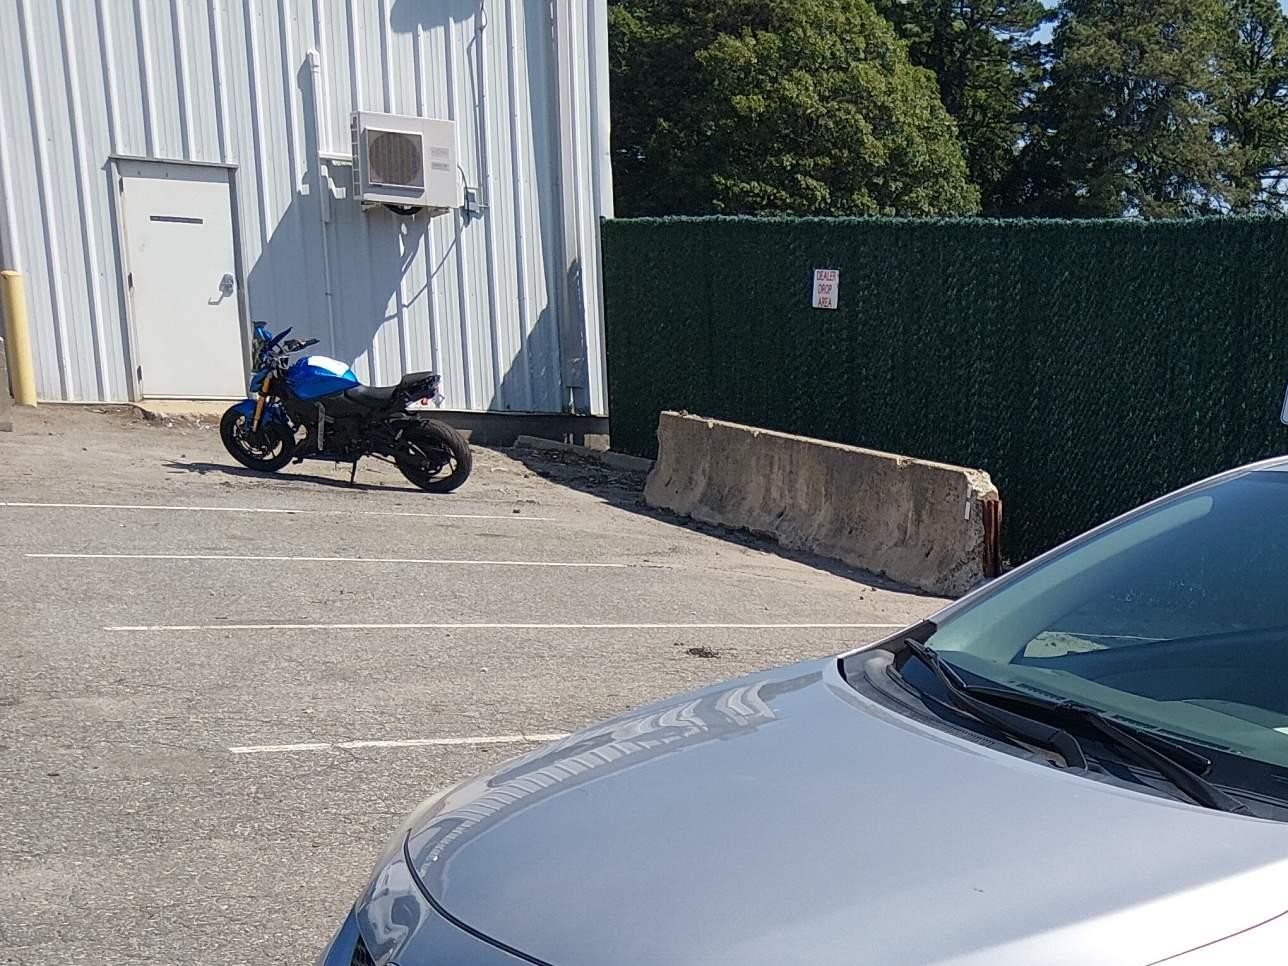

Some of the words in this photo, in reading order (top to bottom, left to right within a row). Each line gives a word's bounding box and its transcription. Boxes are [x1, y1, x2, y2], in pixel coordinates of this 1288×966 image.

[817, 270, 837, 281] DEALER
[818, 284, 832, 294] DROP
[817, 296, 832, 308] AREA
